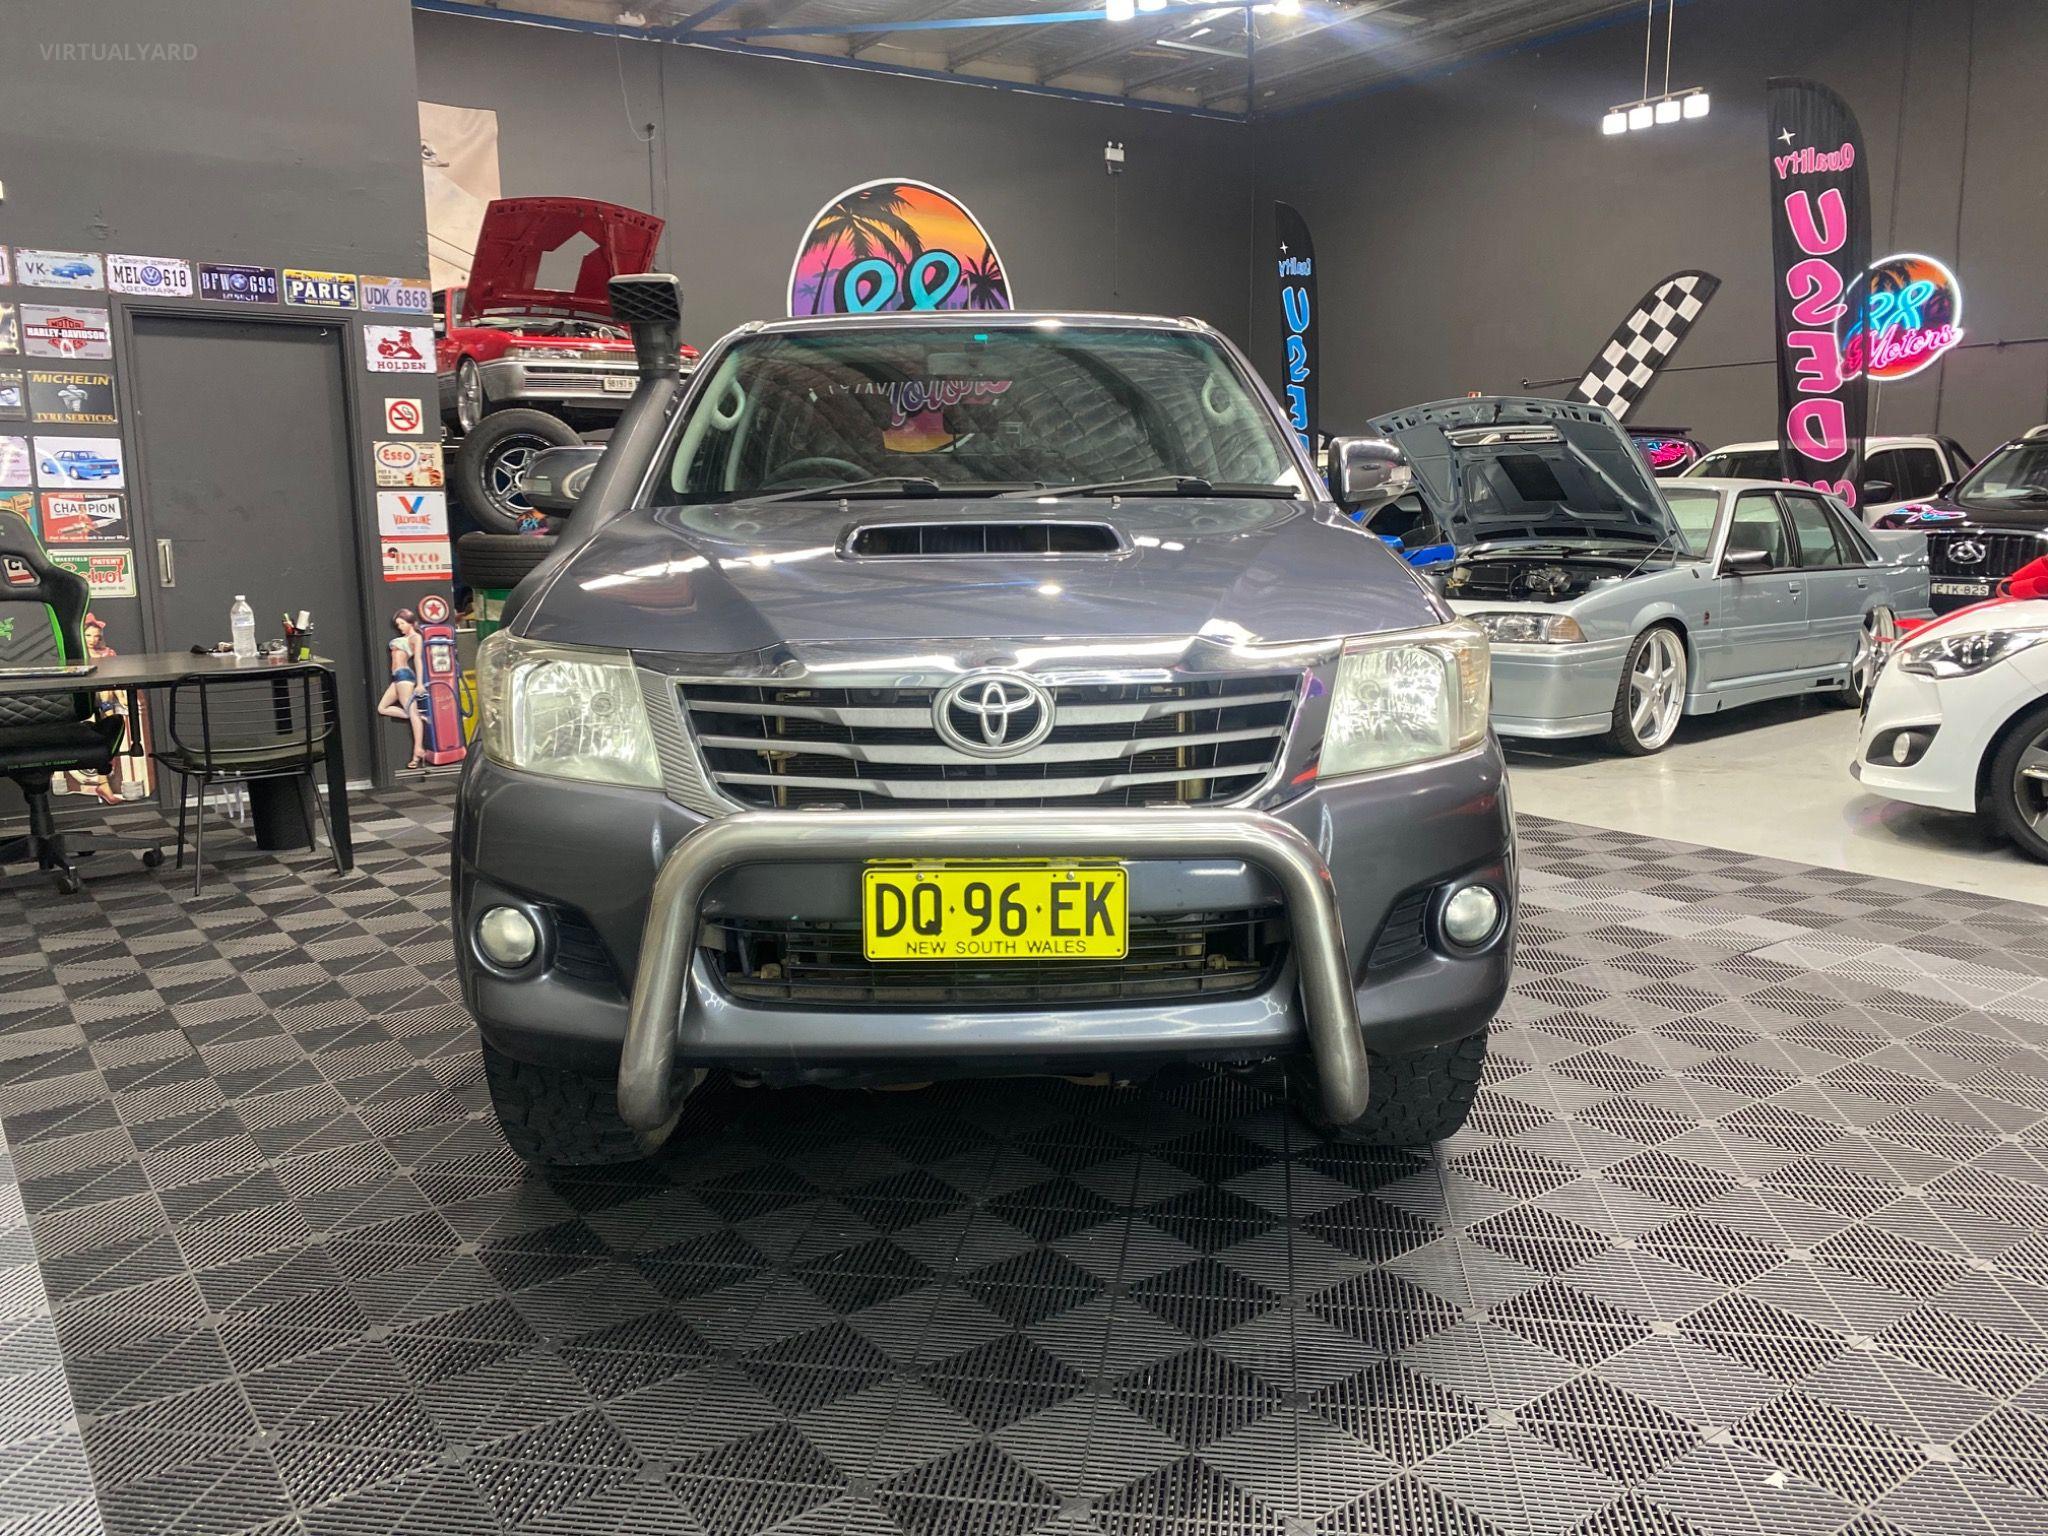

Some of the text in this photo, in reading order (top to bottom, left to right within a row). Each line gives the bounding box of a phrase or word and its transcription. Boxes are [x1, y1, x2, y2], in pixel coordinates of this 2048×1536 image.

[113, 266, 141, 284] MEL
[163, 269, 187, 288] 618
[291, 280, 352, 300] PARIS
[365, 286, 428, 309] UDK 6868
[26, 327, 106, 340] HARLEY-DAVIDSON
[377, 361, 426, 370] HOLDEN
[32, 373, 110, 386] MICHELIN
[36, 412, 114, 423] TYRE SERVICES
[395, 553, 440, 564] RYCO
[907, 940, 1087, 955] NEW SOUTH WALES
